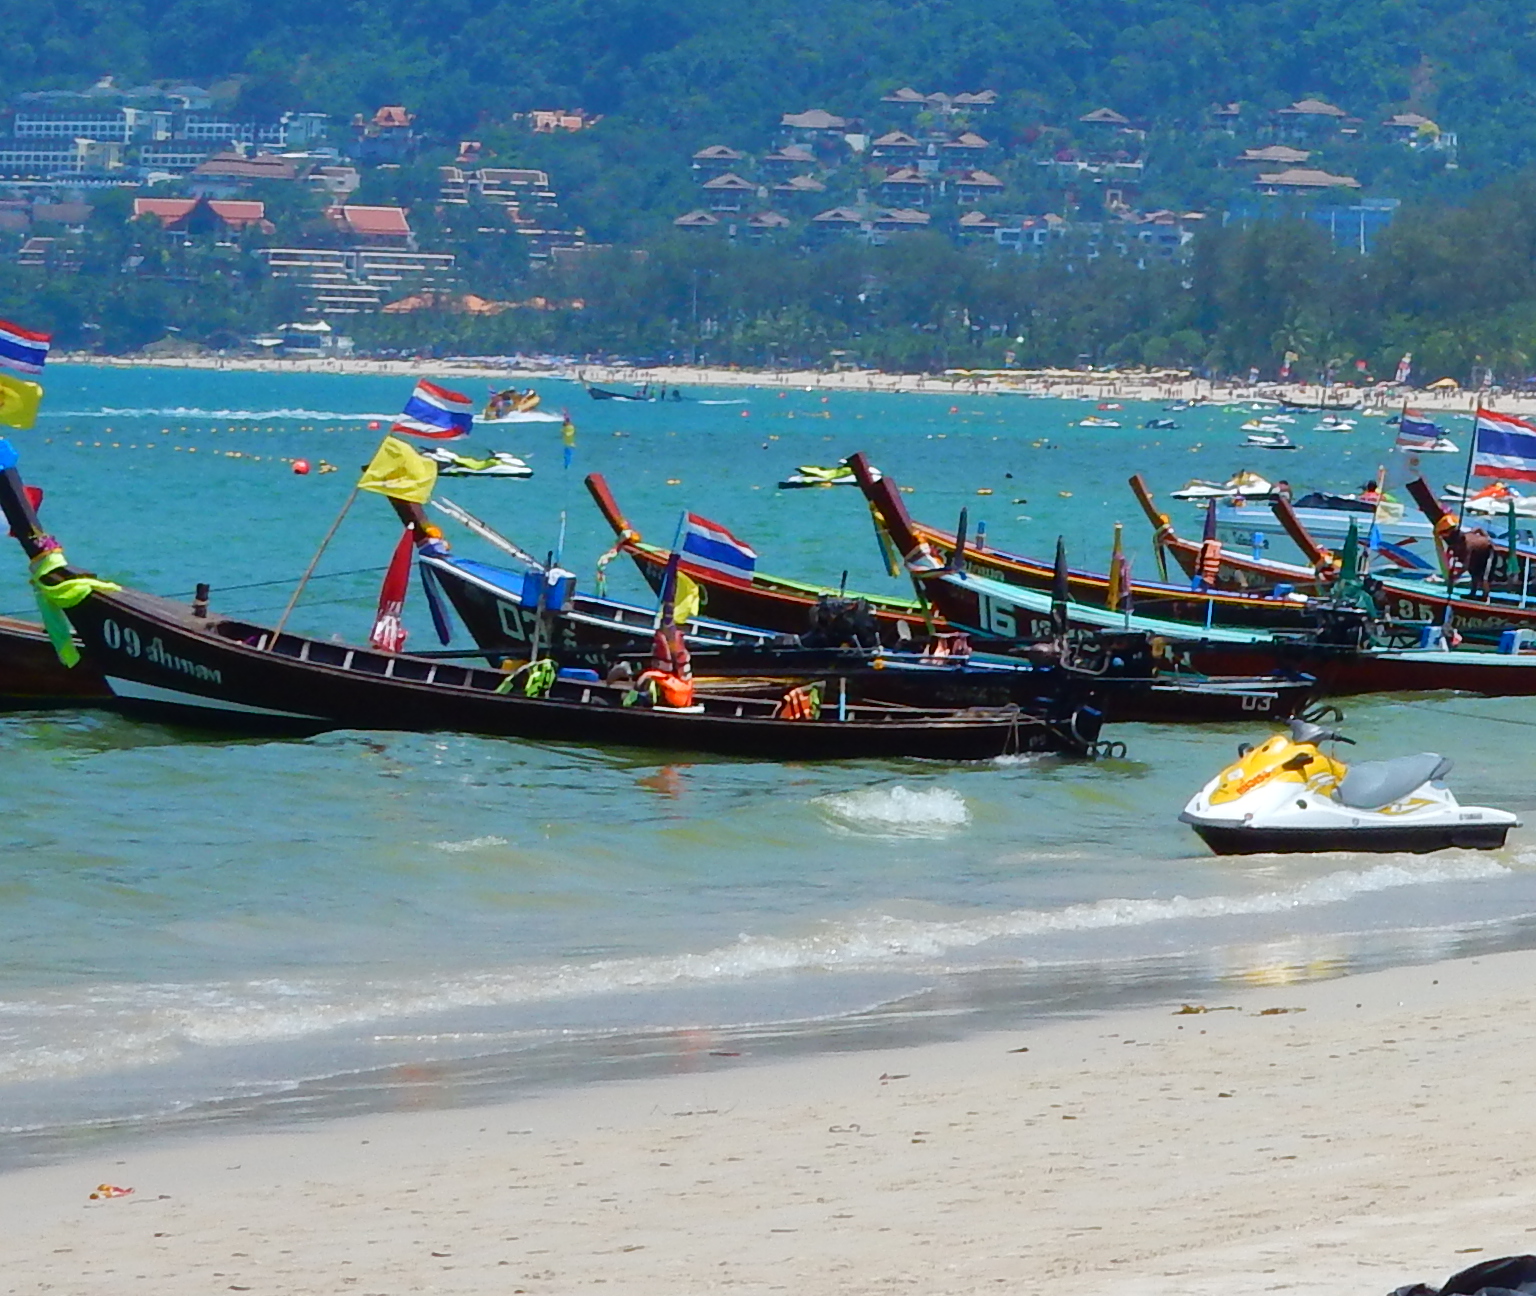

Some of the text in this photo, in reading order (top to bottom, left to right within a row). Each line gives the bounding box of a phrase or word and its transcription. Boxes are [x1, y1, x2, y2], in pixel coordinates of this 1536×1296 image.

[977, 593, 1018, 639] 16
[1398, 598, 1434, 621] 35
[103, 618, 141, 658] 09
